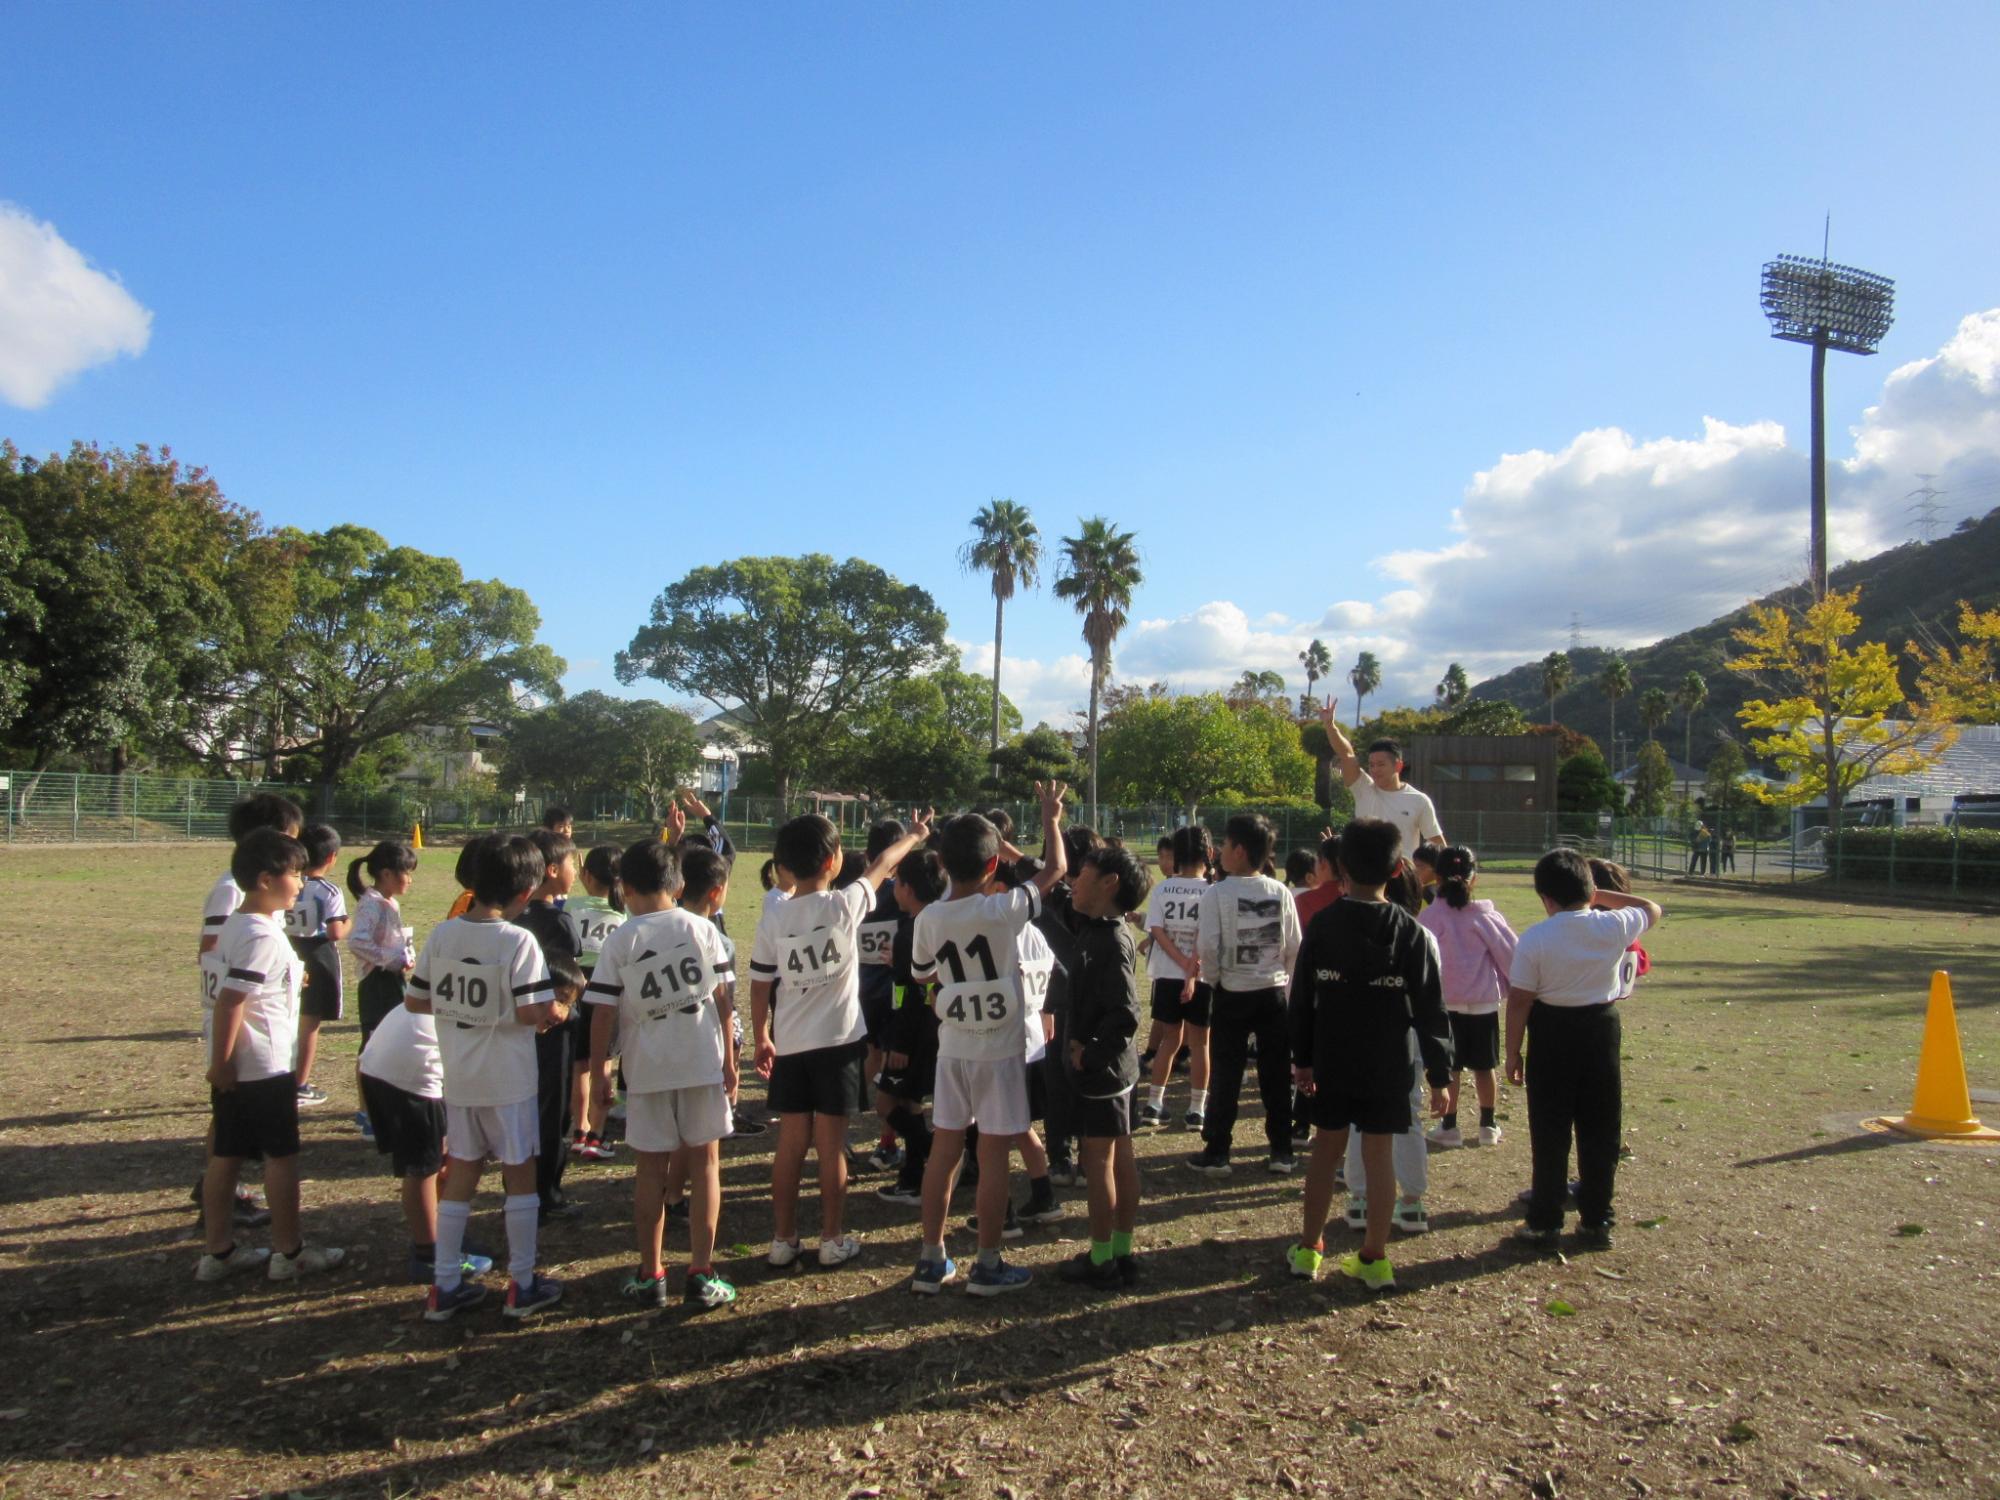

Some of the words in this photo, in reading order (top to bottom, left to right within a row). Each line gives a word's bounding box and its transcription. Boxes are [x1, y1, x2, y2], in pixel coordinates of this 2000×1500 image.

[1165, 901, 1199, 921] 214
[787, 938, 841, 973] 414
[935, 934, 998, 983] 11
[436, 972, 488, 1008] 410
[641, 957, 702, 999] 416
[946, 992, 1007, 1022] 413
